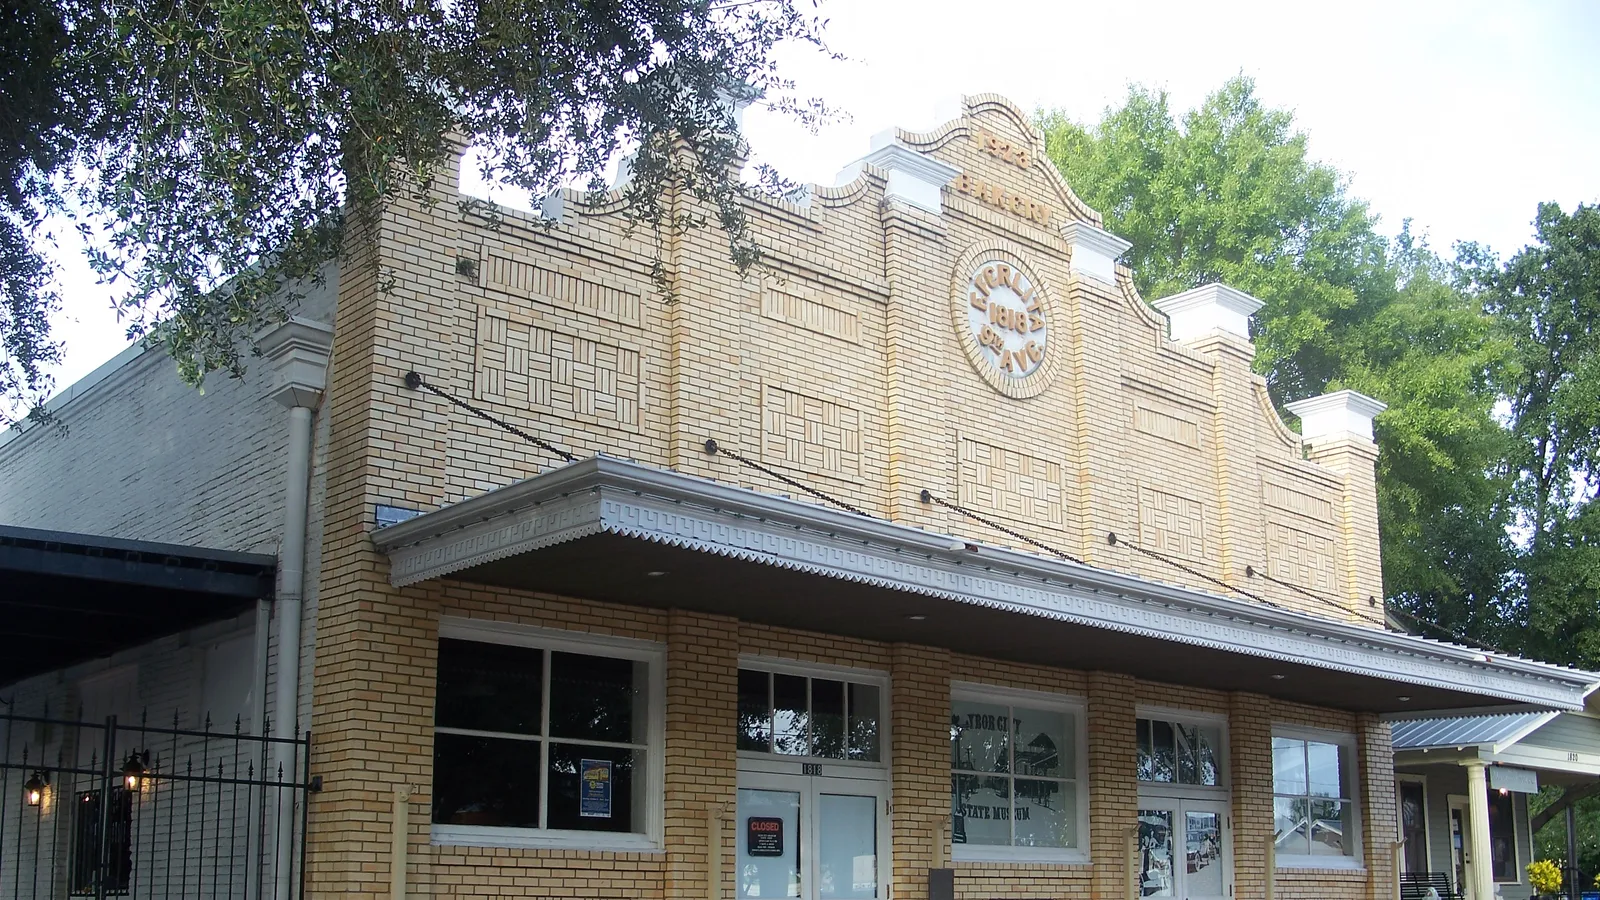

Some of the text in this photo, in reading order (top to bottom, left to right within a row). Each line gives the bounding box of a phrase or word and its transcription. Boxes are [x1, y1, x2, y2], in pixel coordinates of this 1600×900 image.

[956, 170, 1052, 228] BAKERY
[989, 302, 1028, 335] 1818
[967, 713, 1022, 735] YBOR CIY
[803, 764, 822, 775] 1818
[962, 803, 990, 820] STATE
[751, 822, 779, 831] CLOSED
